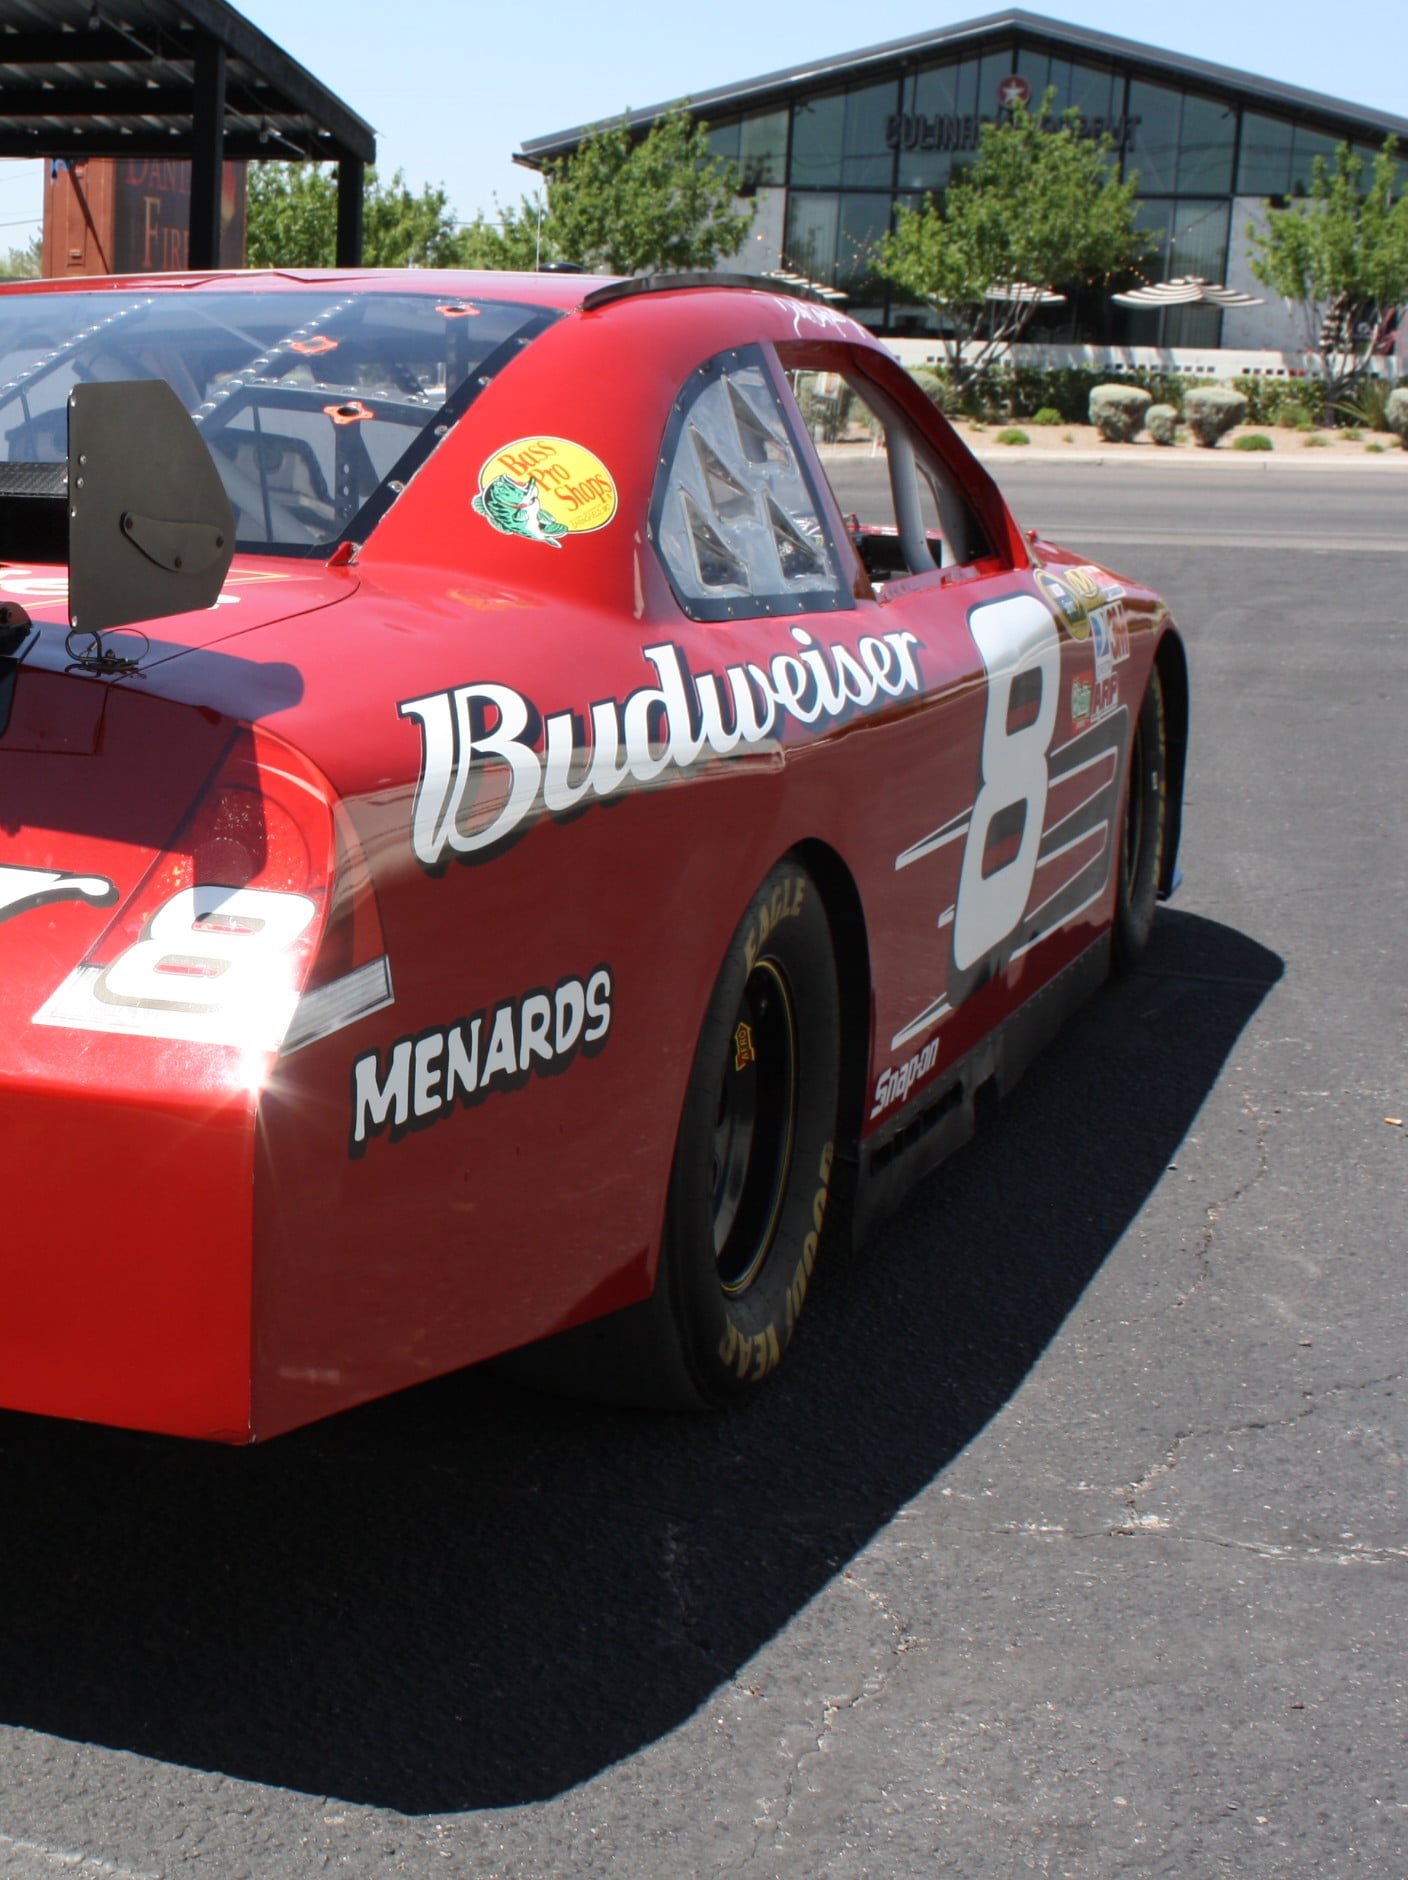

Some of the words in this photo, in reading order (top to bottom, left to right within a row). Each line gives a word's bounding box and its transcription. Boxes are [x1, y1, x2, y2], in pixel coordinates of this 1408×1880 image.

[498, 440, 557, 477] Bass
[527, 463, 570, 492] Pro
[553, 473, 612, 512] Shops
[398, 625, 923, 868] Budweiser
[953, 592, 1062, 972] 8
[96, 885, 316, 1011] 8
[743, 877, 806, 982] EAGLE
[352, 966, 609, 1149] MENARDS
[870, 1037, 940, 1120] Snap-on
